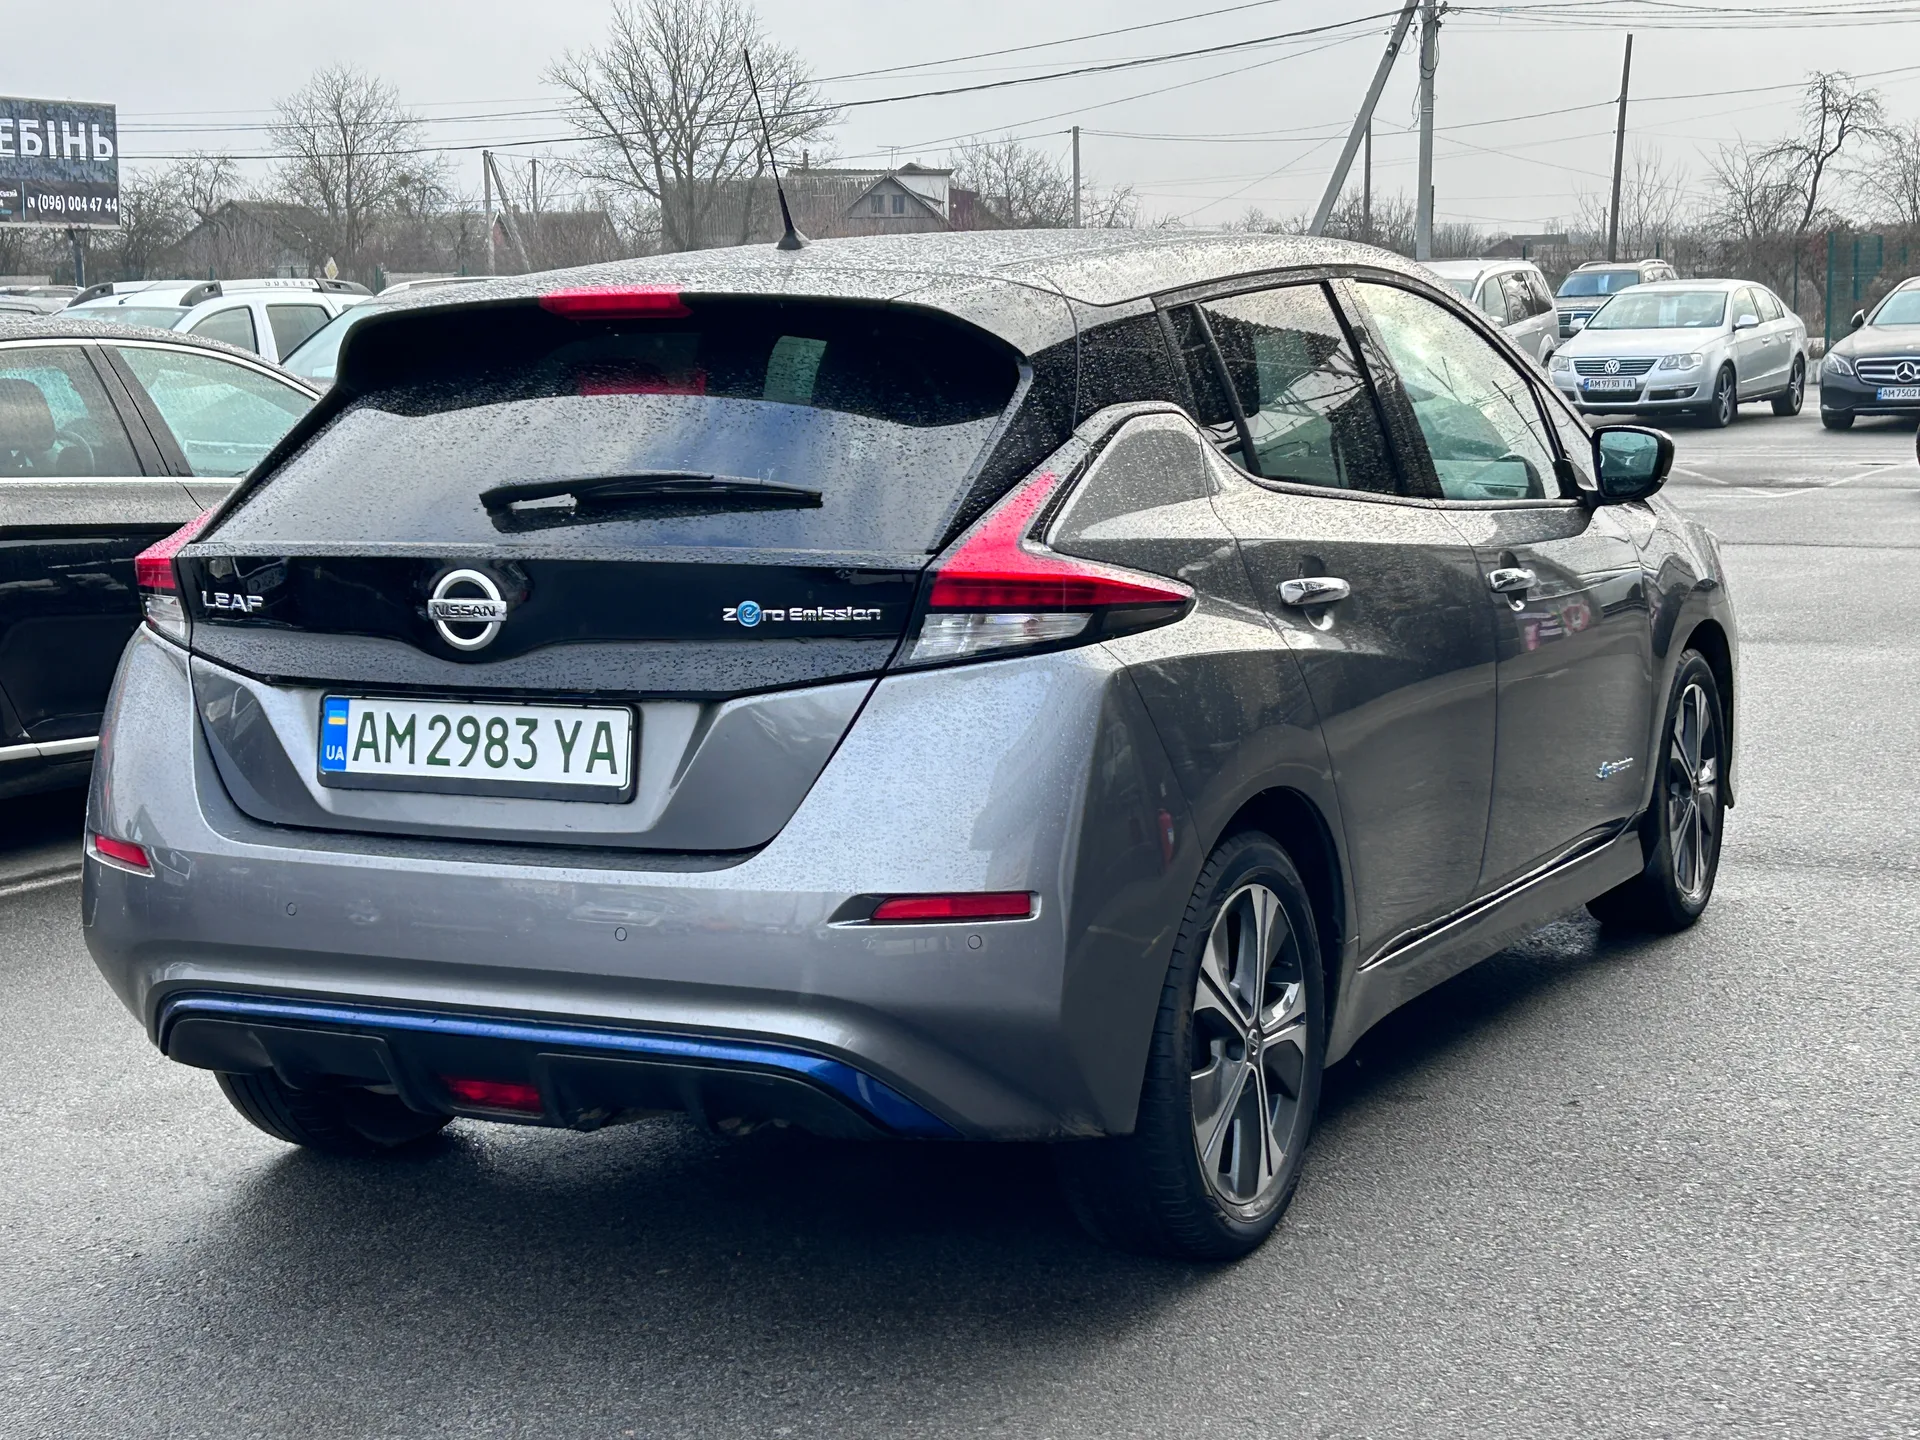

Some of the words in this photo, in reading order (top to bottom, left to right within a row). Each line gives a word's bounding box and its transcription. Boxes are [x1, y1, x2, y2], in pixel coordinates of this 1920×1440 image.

[38, 194, 65, 213] (096)
[68, 196, 87, 211] 004
[89, 197, 102, 211] 47
[105, 198, 118, 212] 44
[201, 590, 264, 612] LEAF
[433, 603, 497, 618] NISSAN
[789, 606, 881, 622] Emission
[352, 711, 416, 765] AM
[426, 714, 539, 770] 2983
[554, 718, 618, 775] YA
[326, 744, 345, 761] UA
